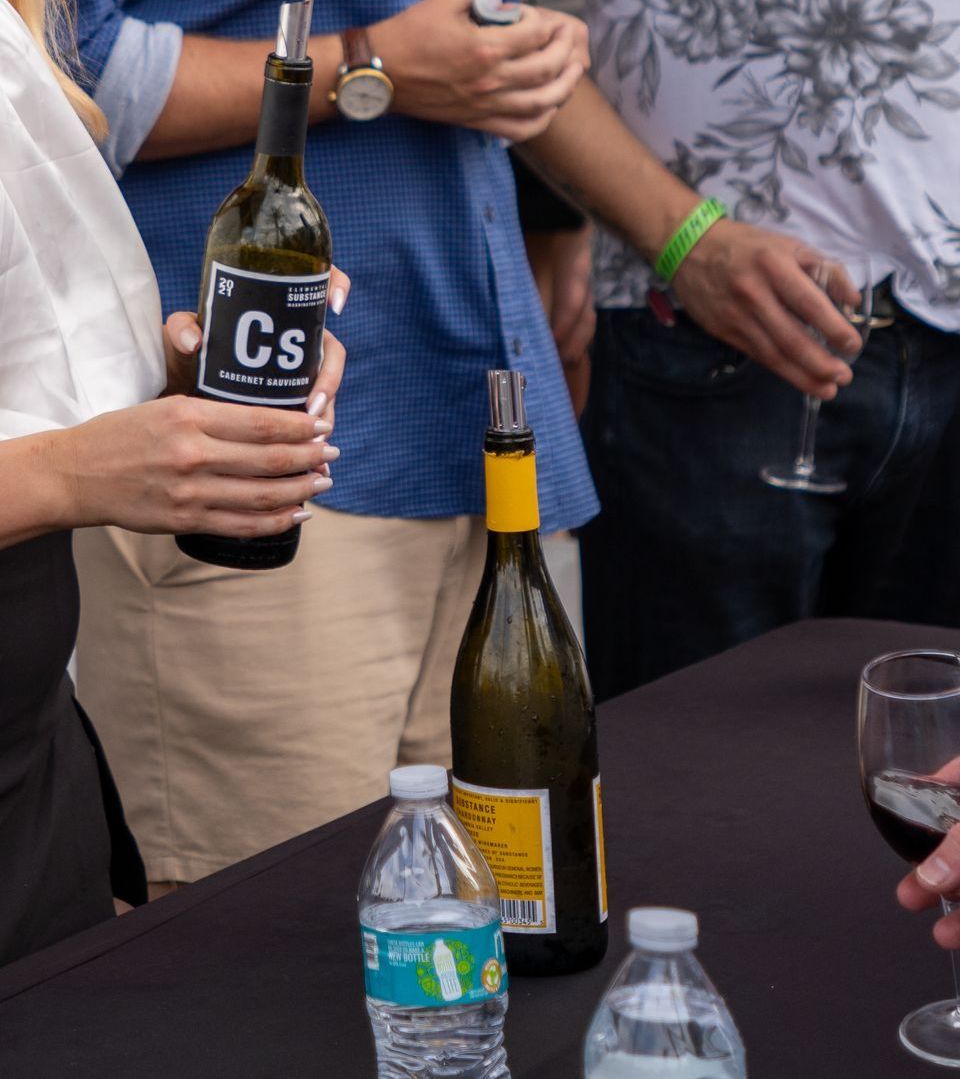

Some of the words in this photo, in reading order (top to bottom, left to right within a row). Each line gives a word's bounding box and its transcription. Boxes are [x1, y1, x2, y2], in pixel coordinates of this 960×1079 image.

[219, 277, 234, 288] 20
[235, 310, 306, 370] Cs
[219, 370, 264, 386] CABERNET
[266, 377, 310, 387] SAUVIGNON
[403, 952, 430, 963] BOTTLE
